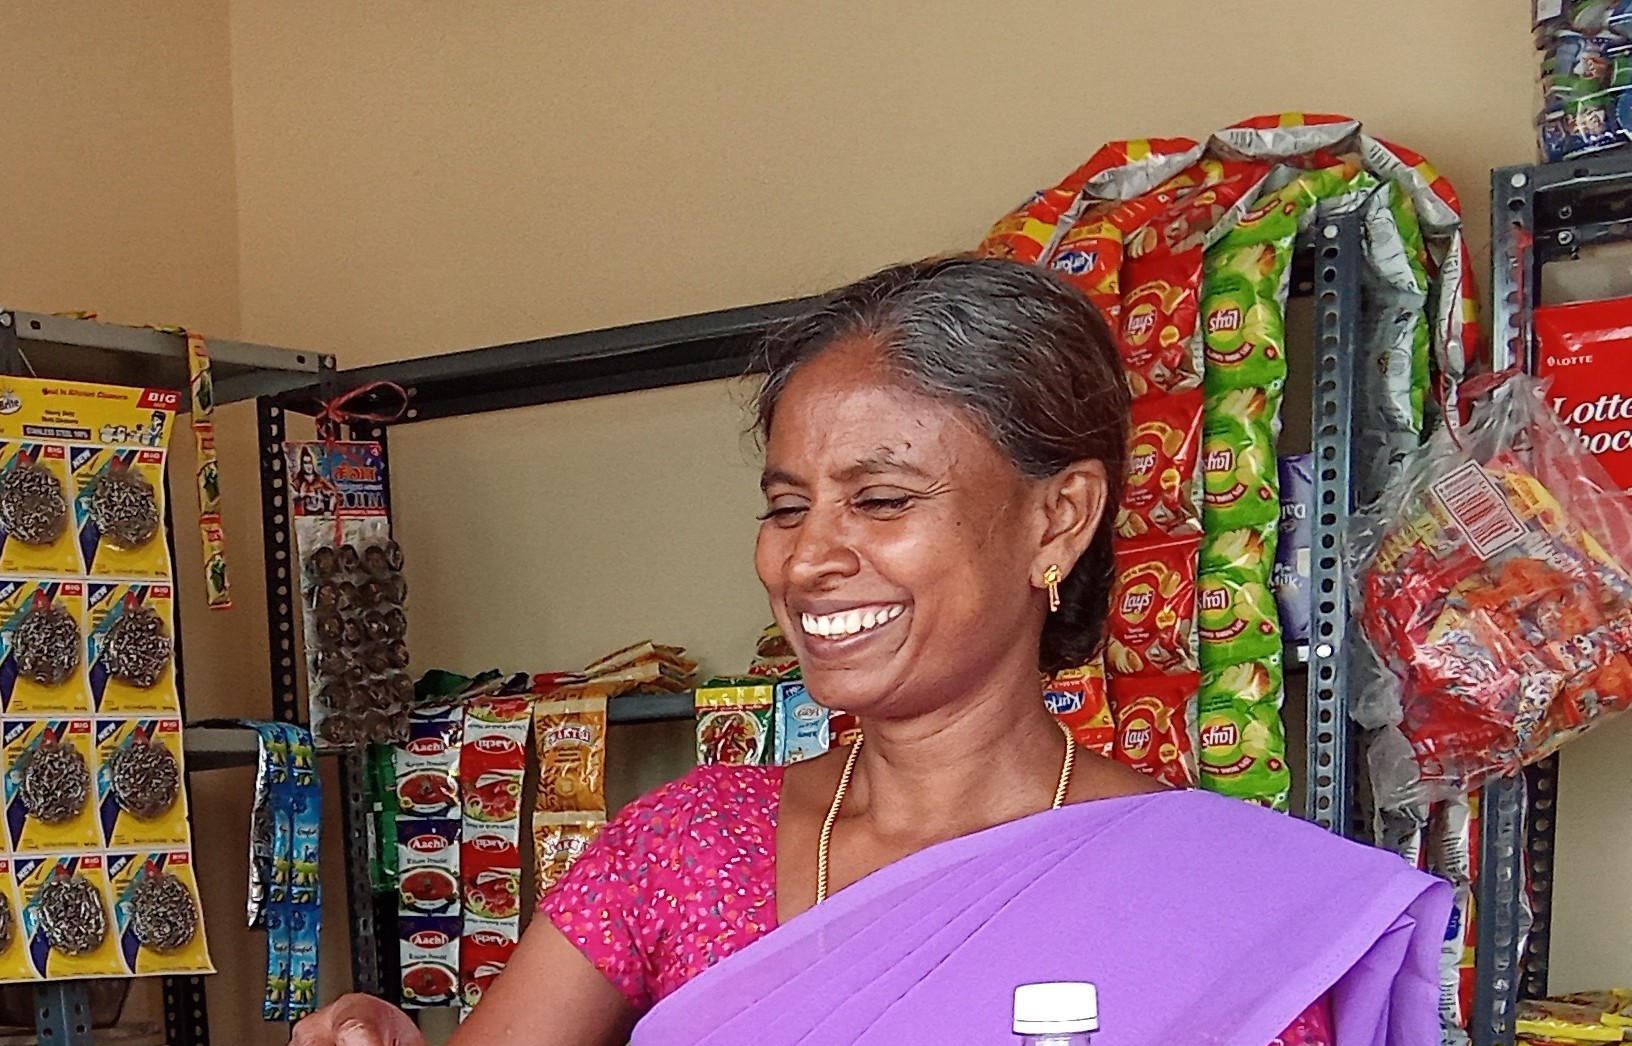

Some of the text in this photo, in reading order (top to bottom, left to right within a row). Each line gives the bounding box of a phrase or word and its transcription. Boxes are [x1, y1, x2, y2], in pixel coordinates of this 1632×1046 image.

[1556, 355, 1594, 366] LOTTE
[147, 392, 177, 404] BIG
[411, 738, 445, 753] Aachi
[412, 836, 445, 850] Aachi
[415, 933, 446, 946] Aachi
